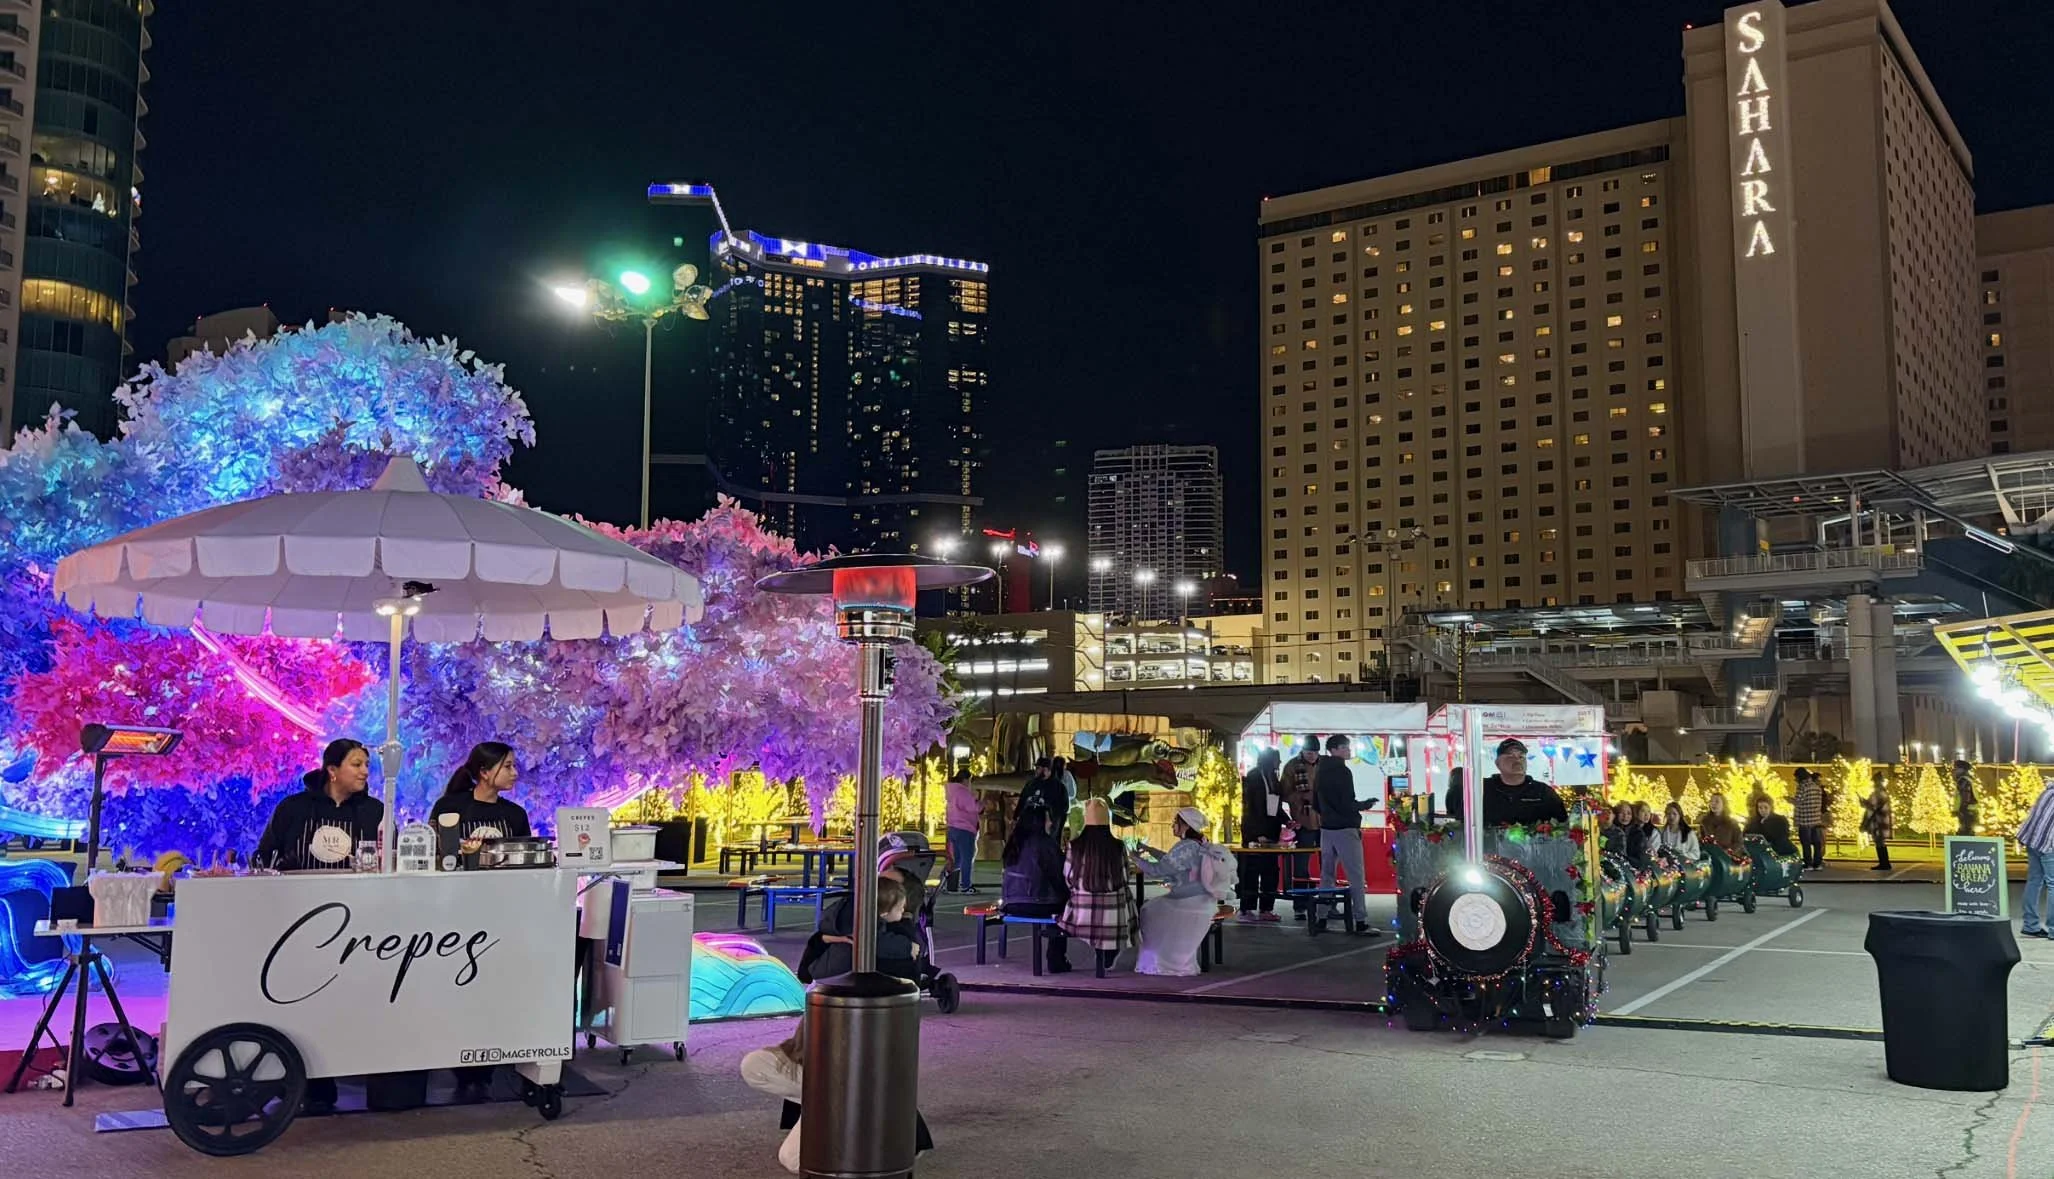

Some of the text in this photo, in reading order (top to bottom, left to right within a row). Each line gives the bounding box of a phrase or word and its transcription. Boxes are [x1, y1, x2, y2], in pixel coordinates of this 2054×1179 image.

[1738, 11, 1776, 258] SAHARA
[1957, 863, 1991, 875] BANANA
[1960, 873, 1989, 882] BREAD
[261, 902, 500, 1004] Crepes
[502, 1047, 570, 1060] MAGEYROLLS
